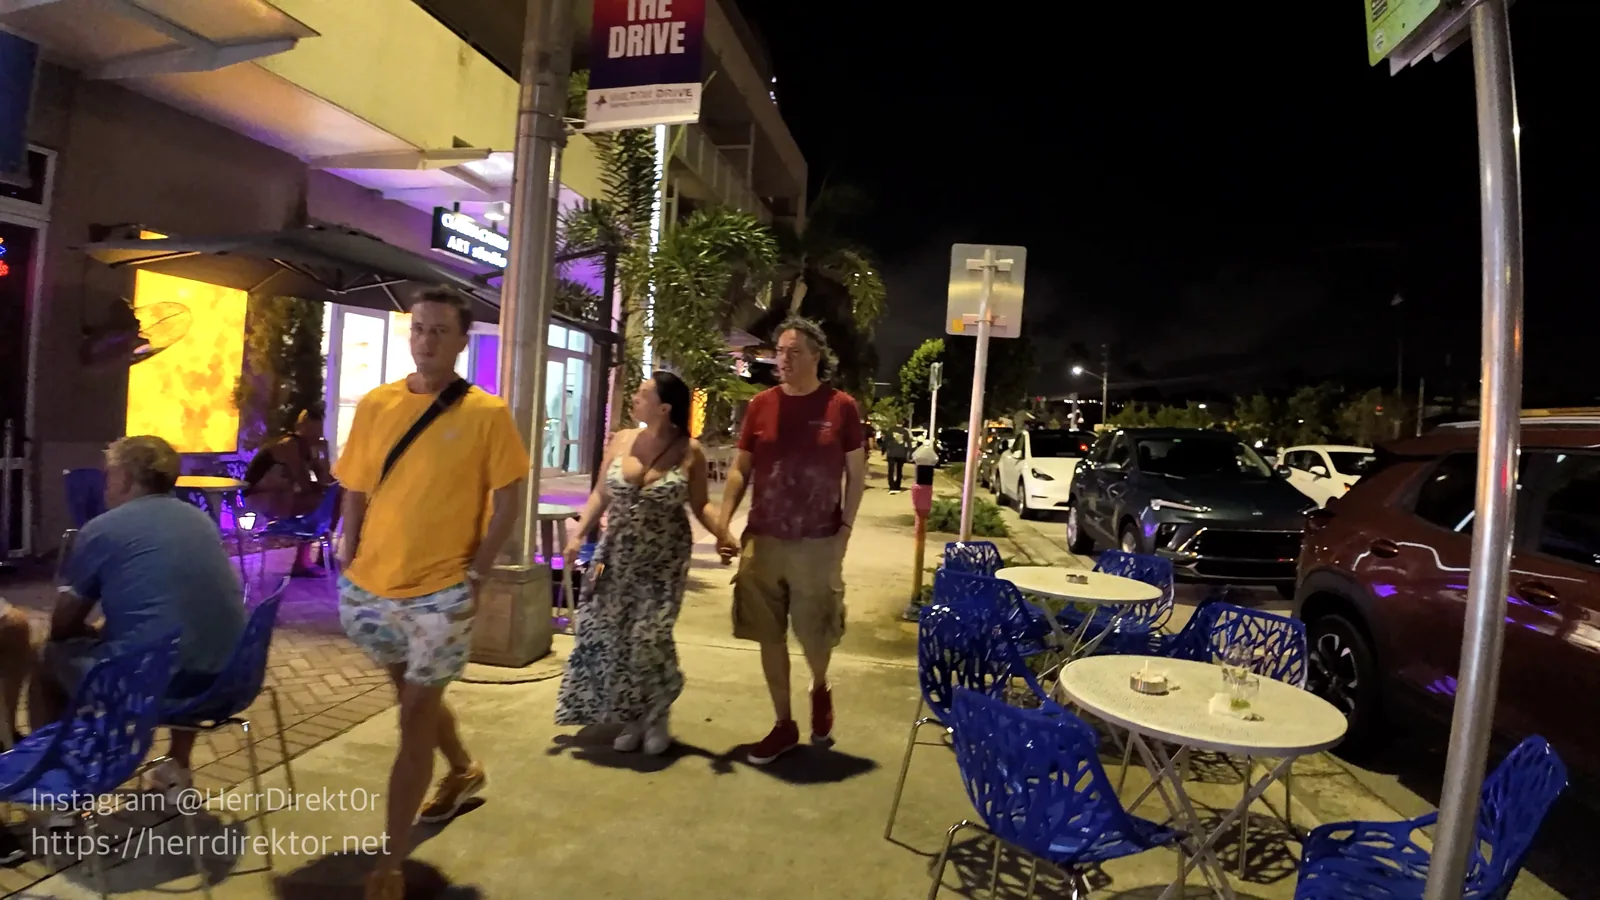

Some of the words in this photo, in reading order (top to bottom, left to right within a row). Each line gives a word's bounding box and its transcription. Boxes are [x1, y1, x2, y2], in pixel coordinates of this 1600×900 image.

[627, 0, 672, 21] THE
[608, 21, 686, 59] DRIVE
[655, 88, 693, 98] DRIVE
